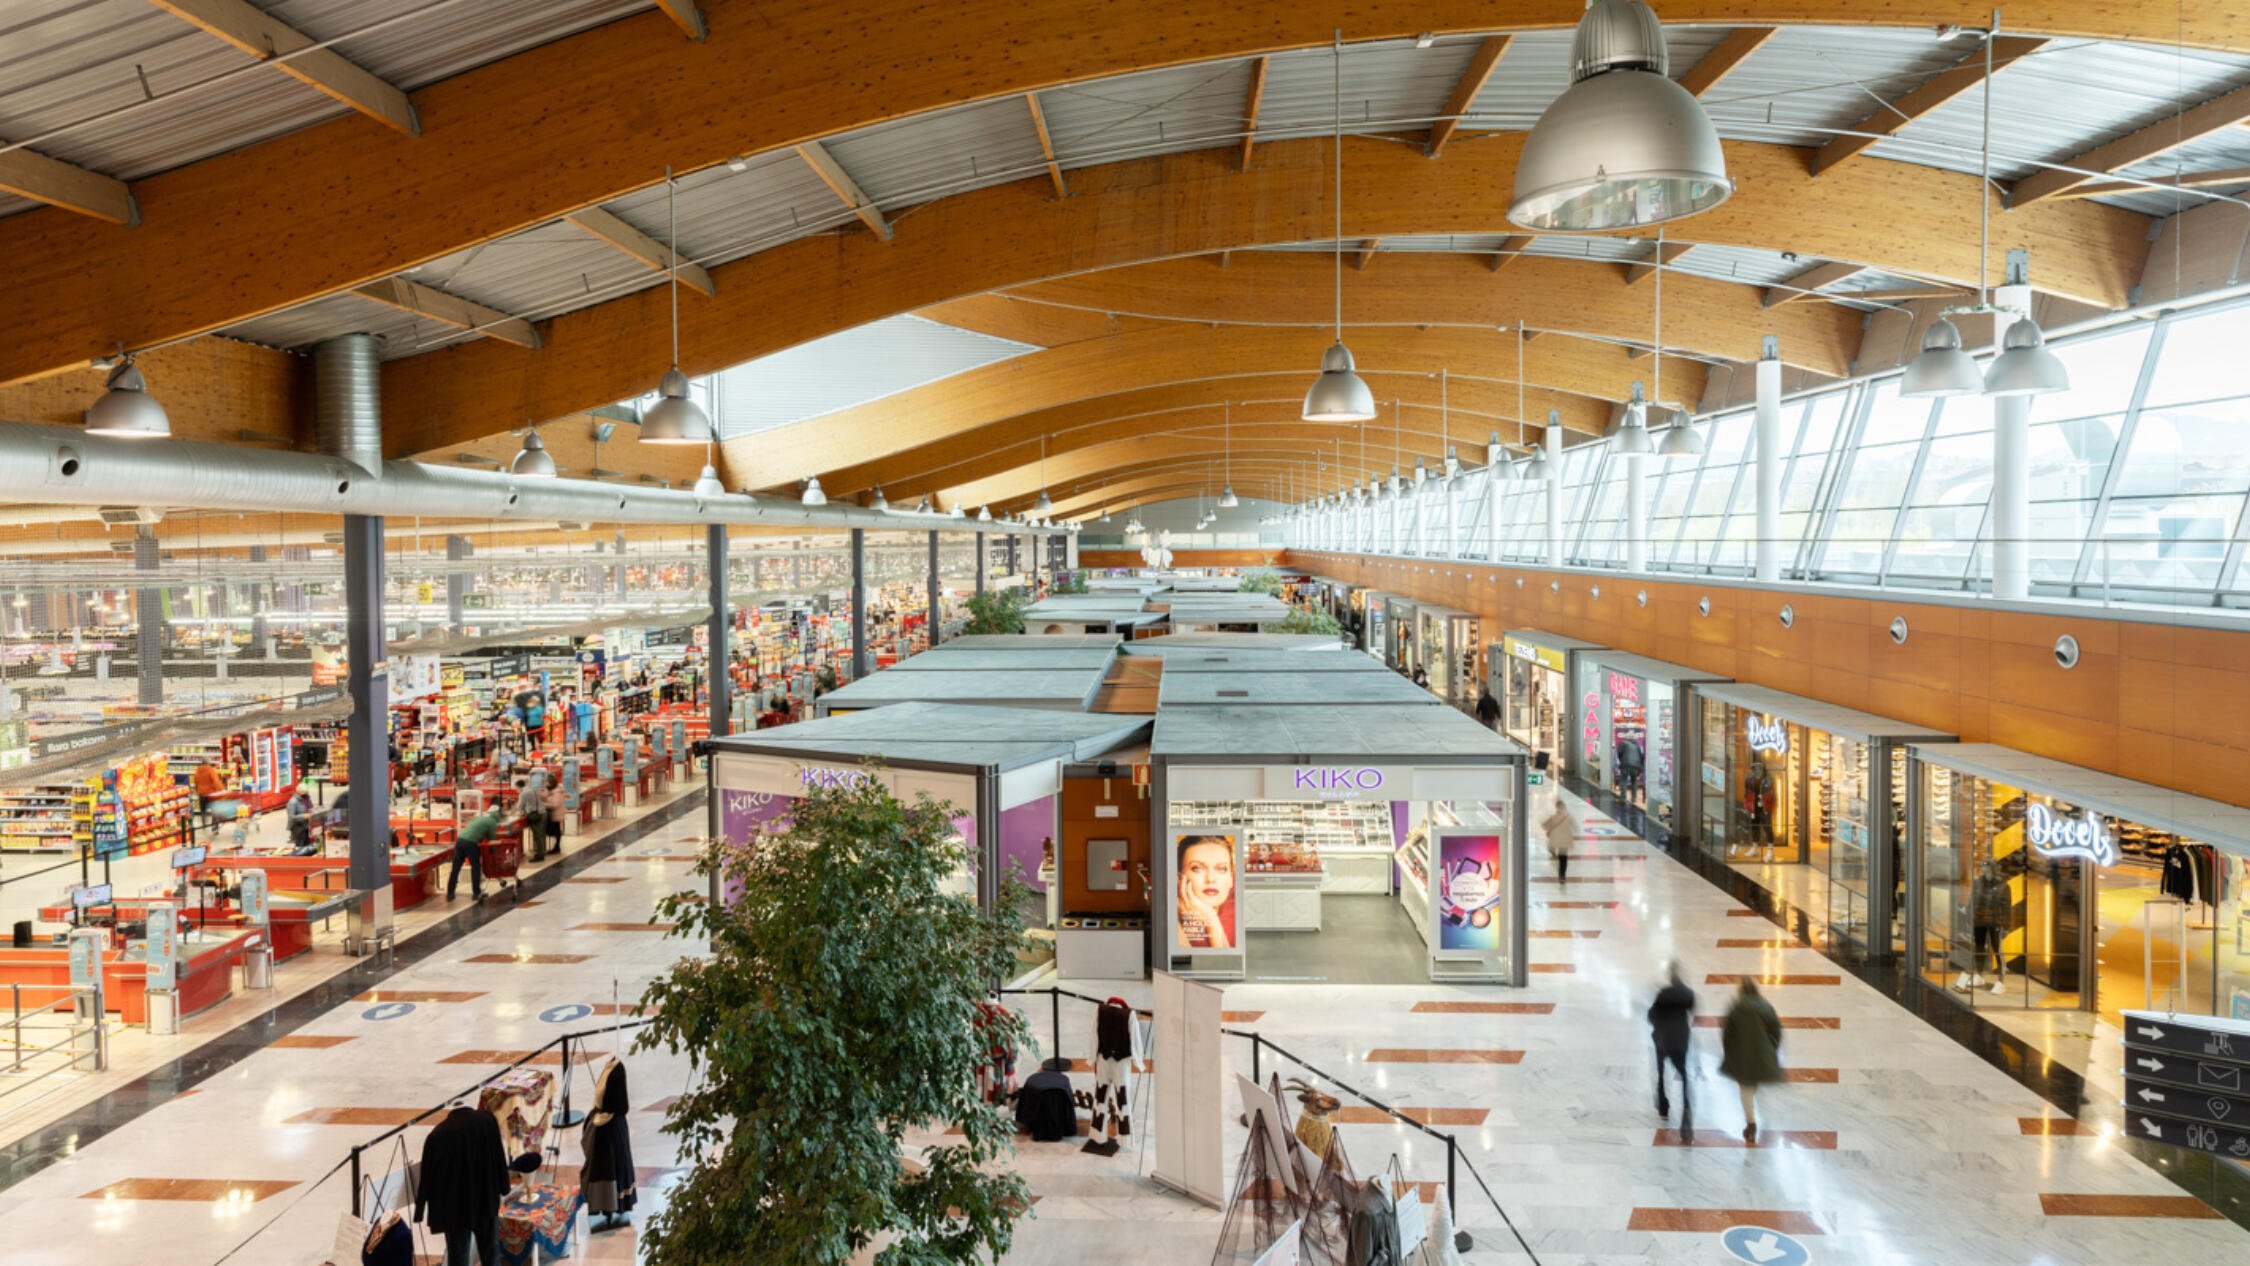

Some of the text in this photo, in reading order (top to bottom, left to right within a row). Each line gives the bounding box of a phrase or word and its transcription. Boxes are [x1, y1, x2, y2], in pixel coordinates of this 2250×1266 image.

[1609, 672, 1638, 701] GAME
[801, 766, 870, 793] KIKO
[1295, 767, 1383, 790] KIKO
[729, 791, 773, 813] KIKO
